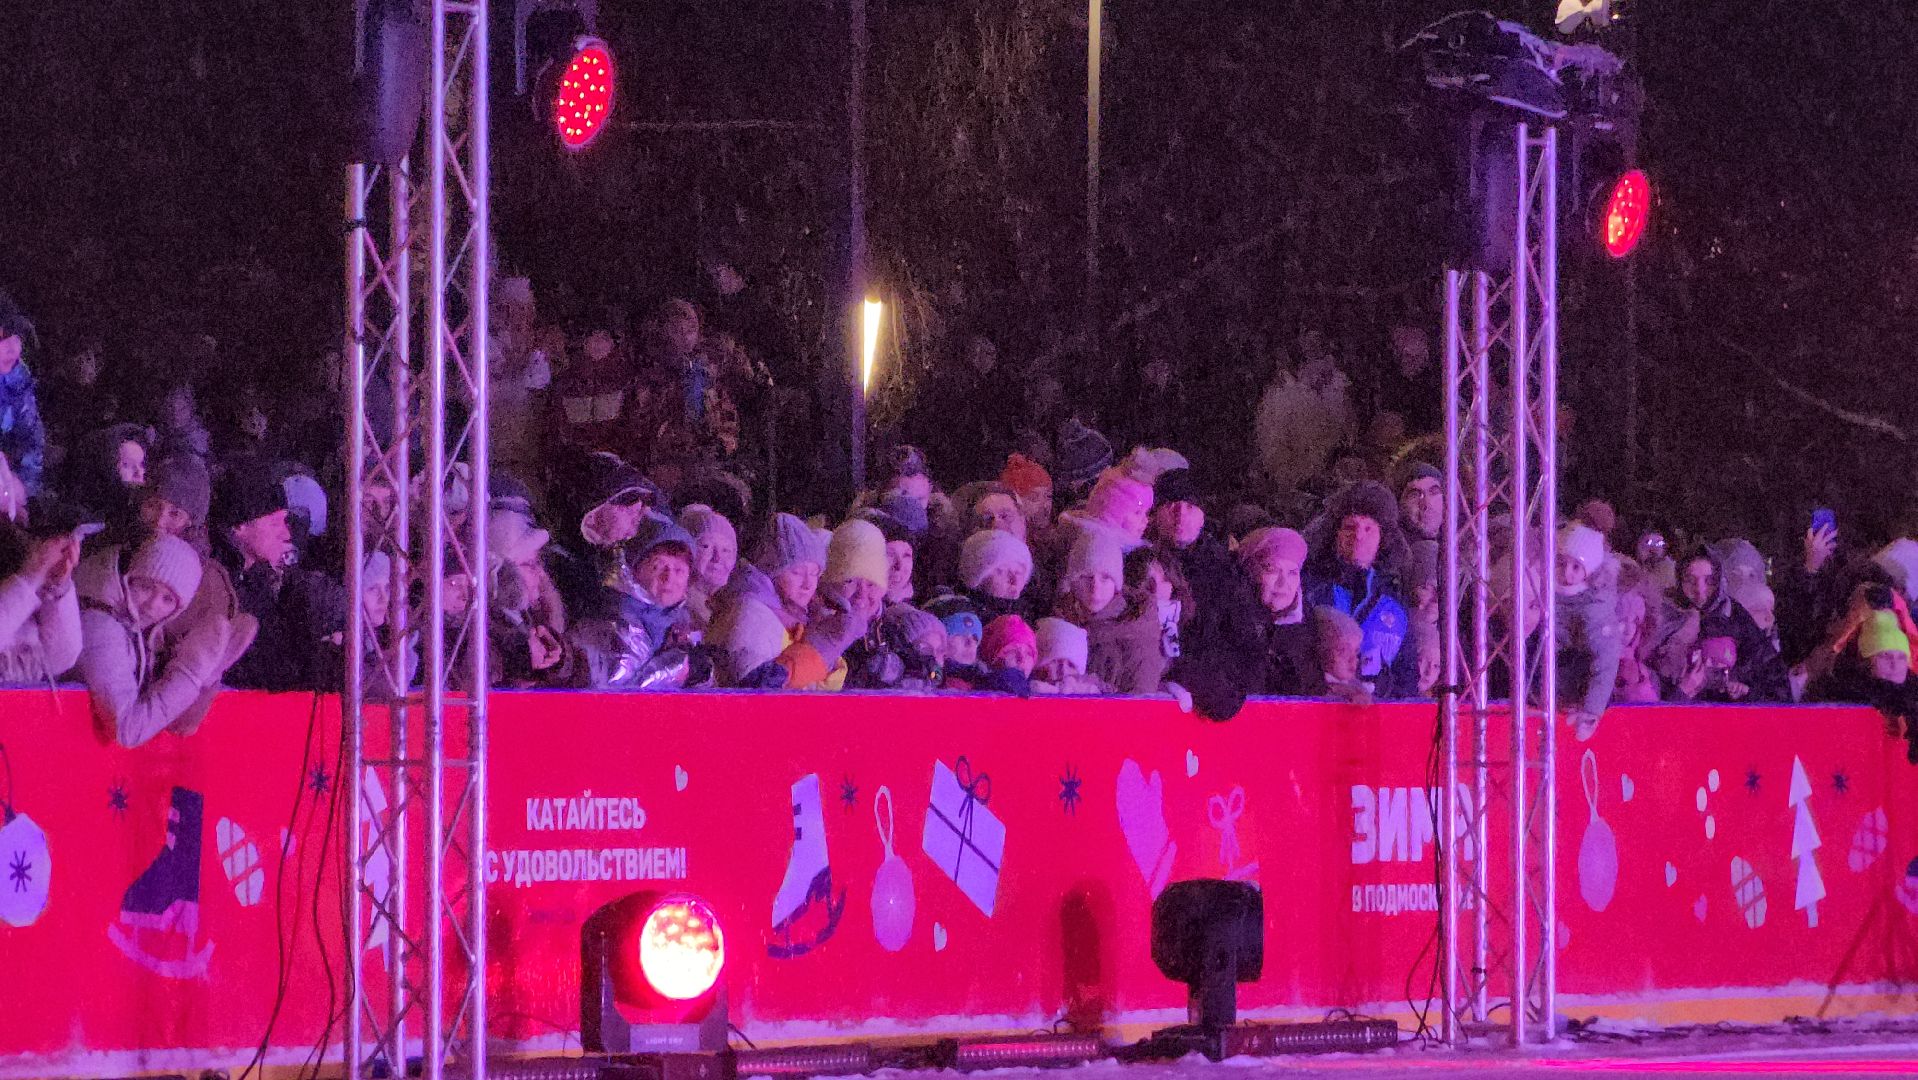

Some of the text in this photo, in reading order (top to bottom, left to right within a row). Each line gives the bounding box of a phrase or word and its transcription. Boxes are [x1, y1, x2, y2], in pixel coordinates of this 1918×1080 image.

[526, 789, 646, 830] КАТАЙТЕСЬ
[485, 848, 687, 888] С УДОВОЛЬСТВИЕМ!
[1352, 883, 1474, 916] В ПОДМОСКЬЕ
